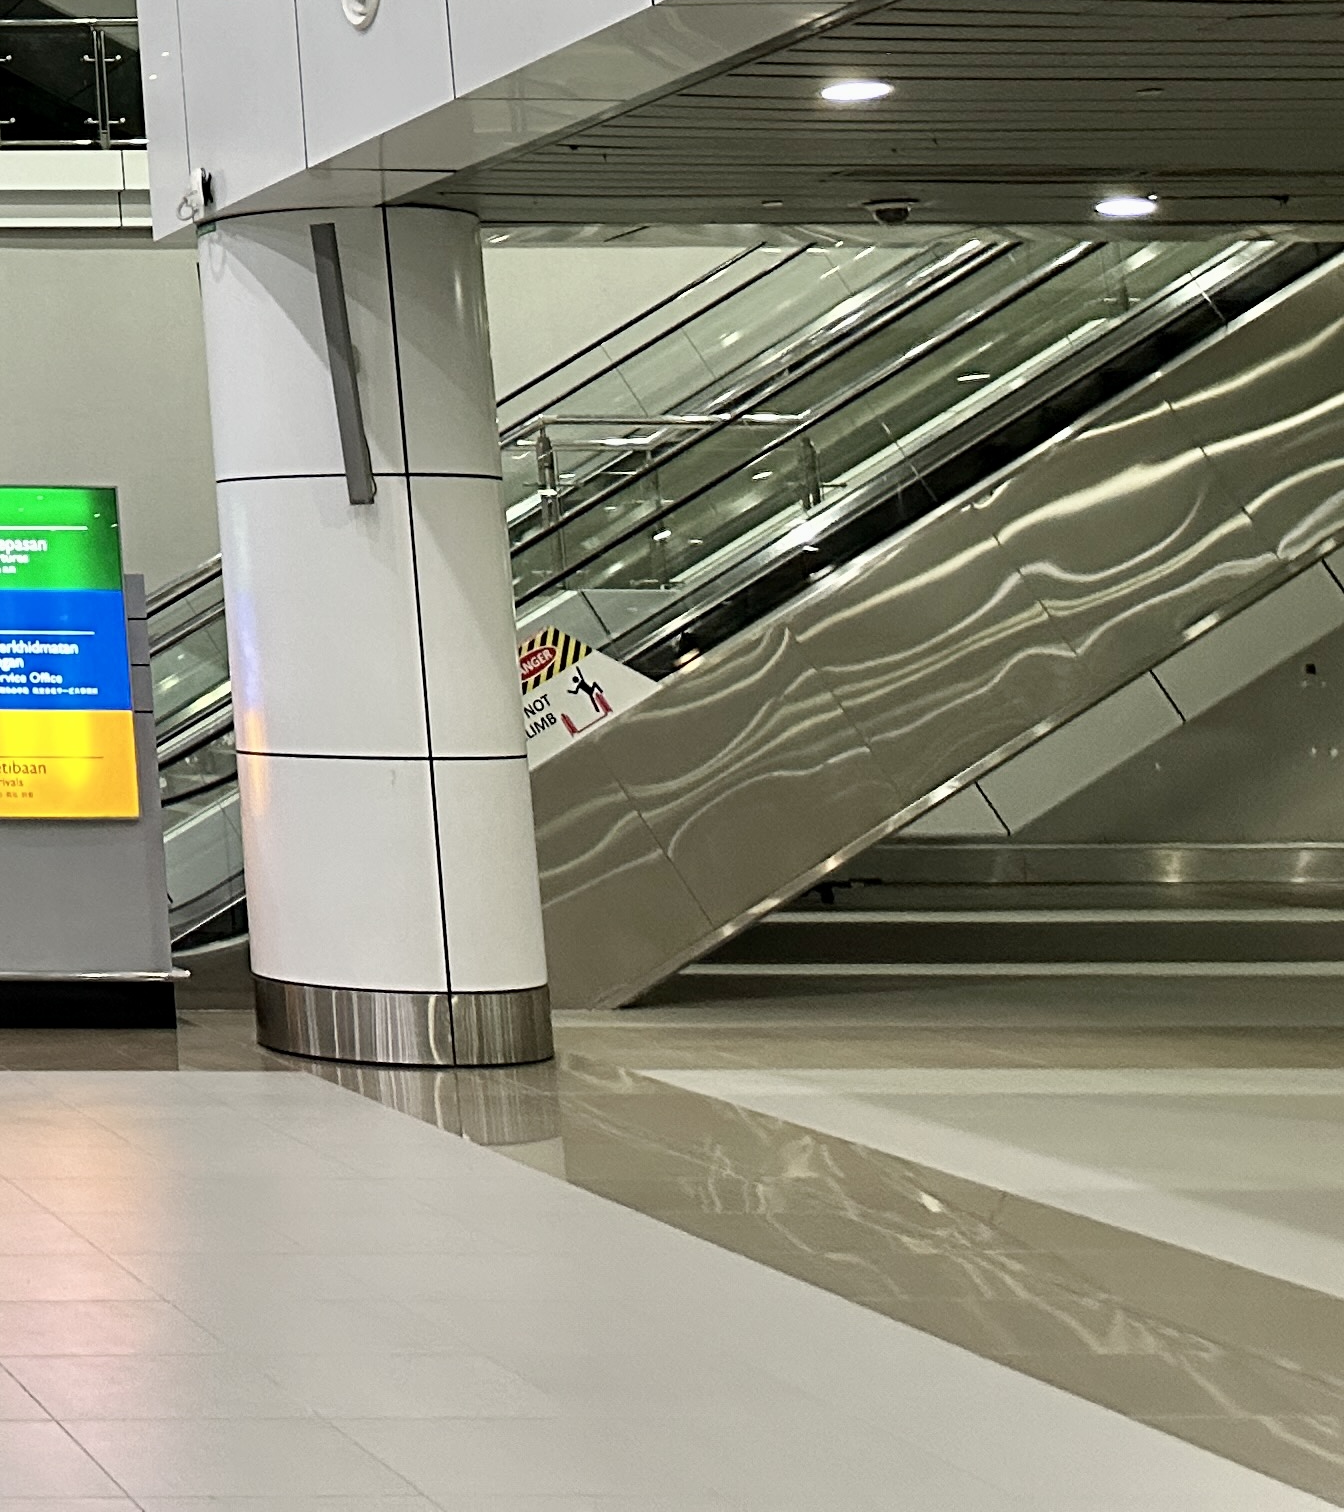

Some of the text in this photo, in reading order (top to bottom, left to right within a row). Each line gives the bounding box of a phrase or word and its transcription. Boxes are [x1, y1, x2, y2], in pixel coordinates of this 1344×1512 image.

[522, 649, 553, 675] NGER
[29, 671, 63, 683] Office
[523, 693, 550, 719] NOT
[525, 712, 557, 739] LIMB
